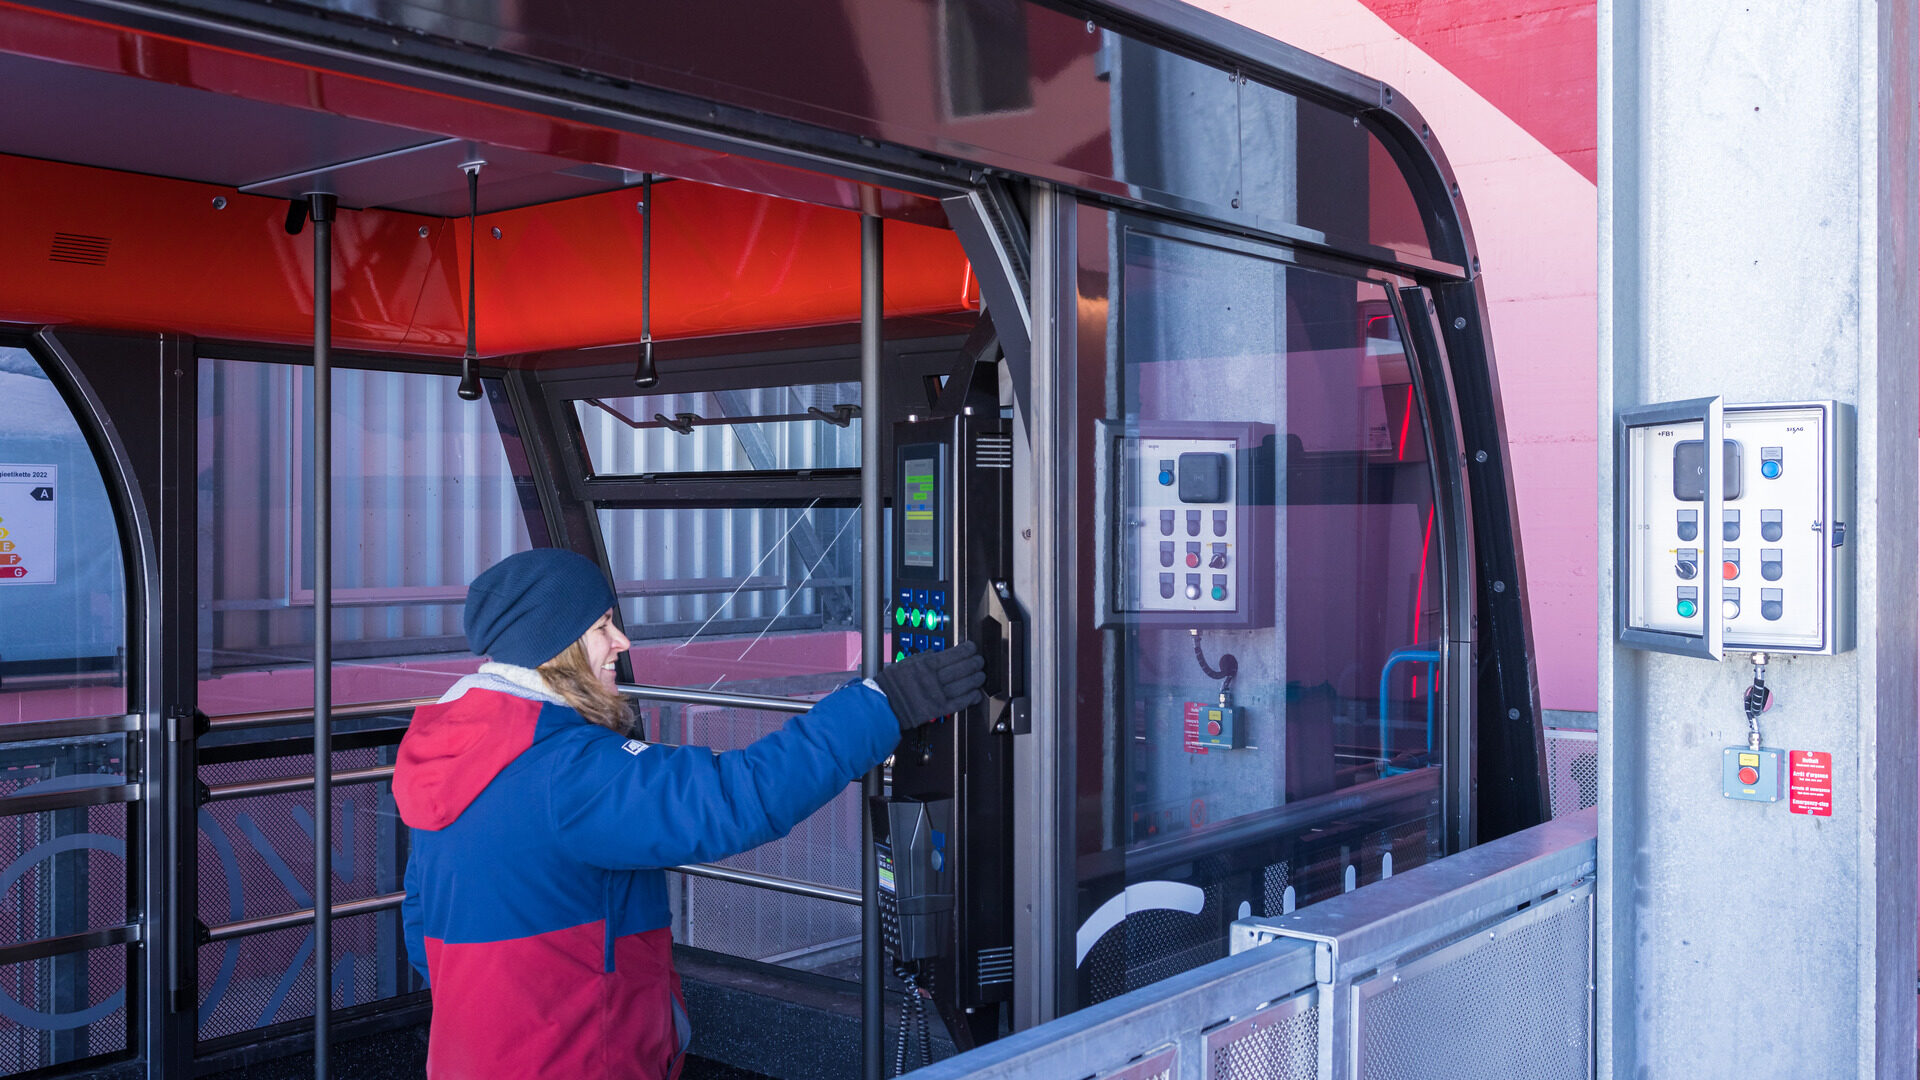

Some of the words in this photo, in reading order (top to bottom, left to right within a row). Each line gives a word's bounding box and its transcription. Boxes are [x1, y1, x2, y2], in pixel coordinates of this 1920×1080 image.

[40, 489, 49, 498] A
[3, 542, 10, 551] E
[9, 555, 17, 564] F
[14, 568, 23, 577] G
